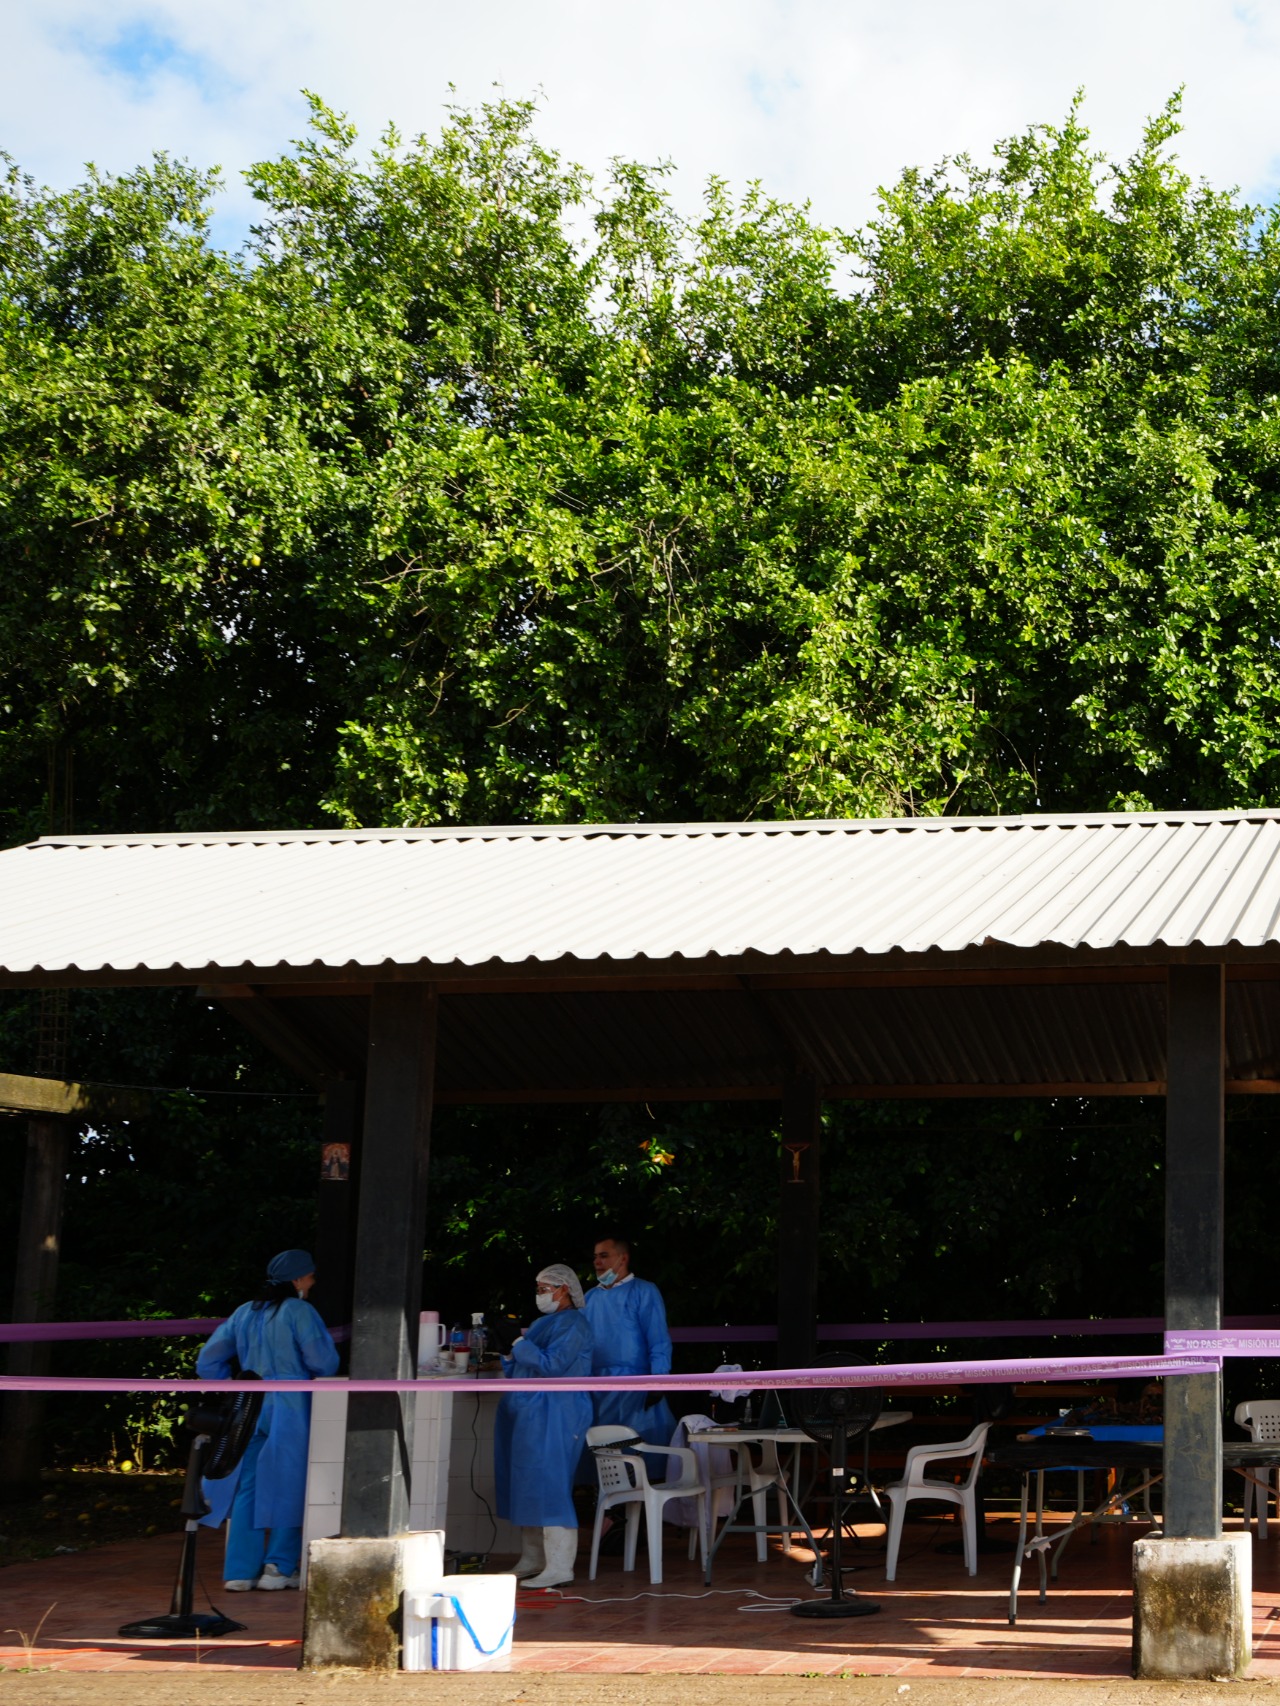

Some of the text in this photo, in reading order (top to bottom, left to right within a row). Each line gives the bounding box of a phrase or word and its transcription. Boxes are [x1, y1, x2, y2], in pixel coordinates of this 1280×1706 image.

[1186, 1340, 1199, 1348] NO
[1201, 1340, 1222, 1349] PASE
[1239, 1338, 1266, 1348] MISIÓN
[812, 1375, 838, 1384] MISIÓN
[842, 1373, 897, 1383] HUMANITARIA
[928, 1372, 949, 1380] PASE
[964, 1367, 993, 1378] MISIÓN
[995, 1366, 1051, 1376] HUMANITARIA
[1081, 1364, 1103, 1372] PASE
[1119, 1360, 1146, 1370] MISIÓN
[1149, 1355, 1205, 1368] HUMANITARIA
